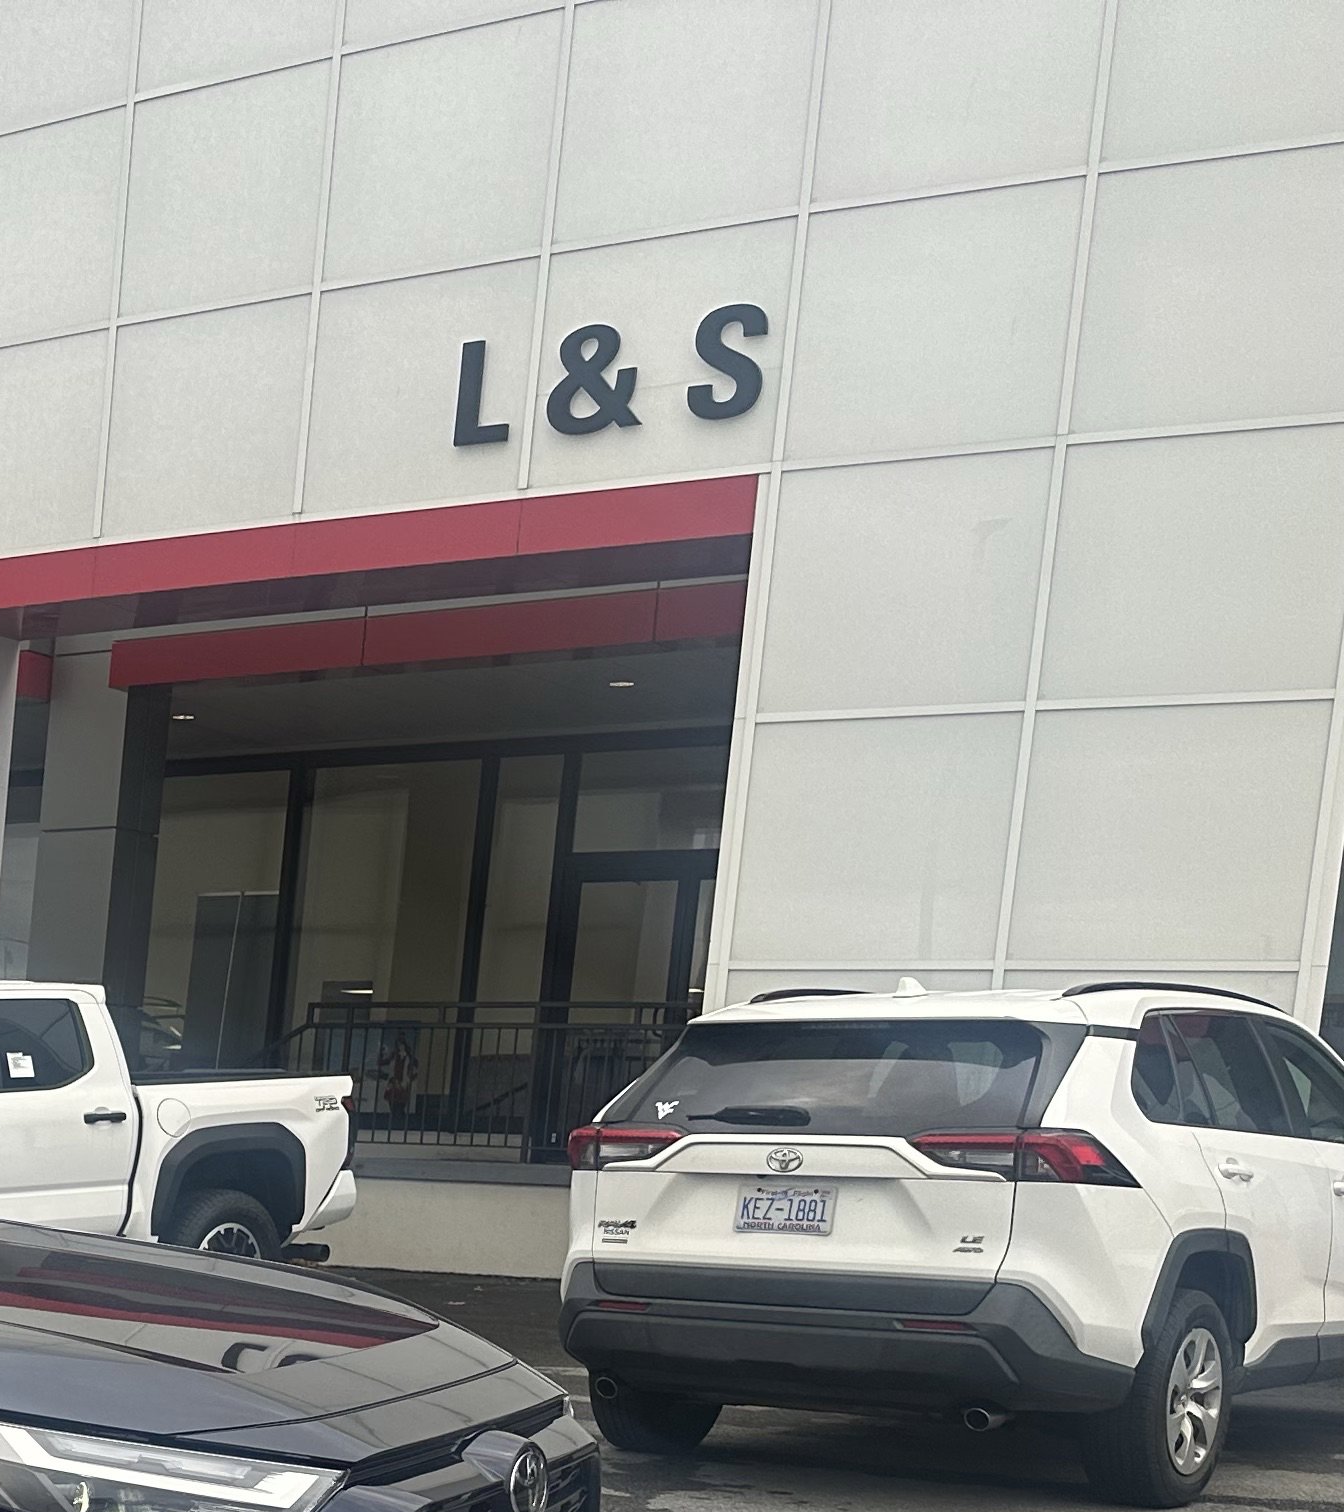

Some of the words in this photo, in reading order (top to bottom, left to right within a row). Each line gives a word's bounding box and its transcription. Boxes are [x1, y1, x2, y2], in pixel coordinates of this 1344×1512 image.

[453, 340, 510, 447] L
[546, 323, 642, 435] &
[687, 303, 769, 420] S
[740, 1196, 828, 1223] KEZ-1881
[742, 1221, 774, 1231] NORTH
[777, 1222, 821, 1231] CAROLINA
